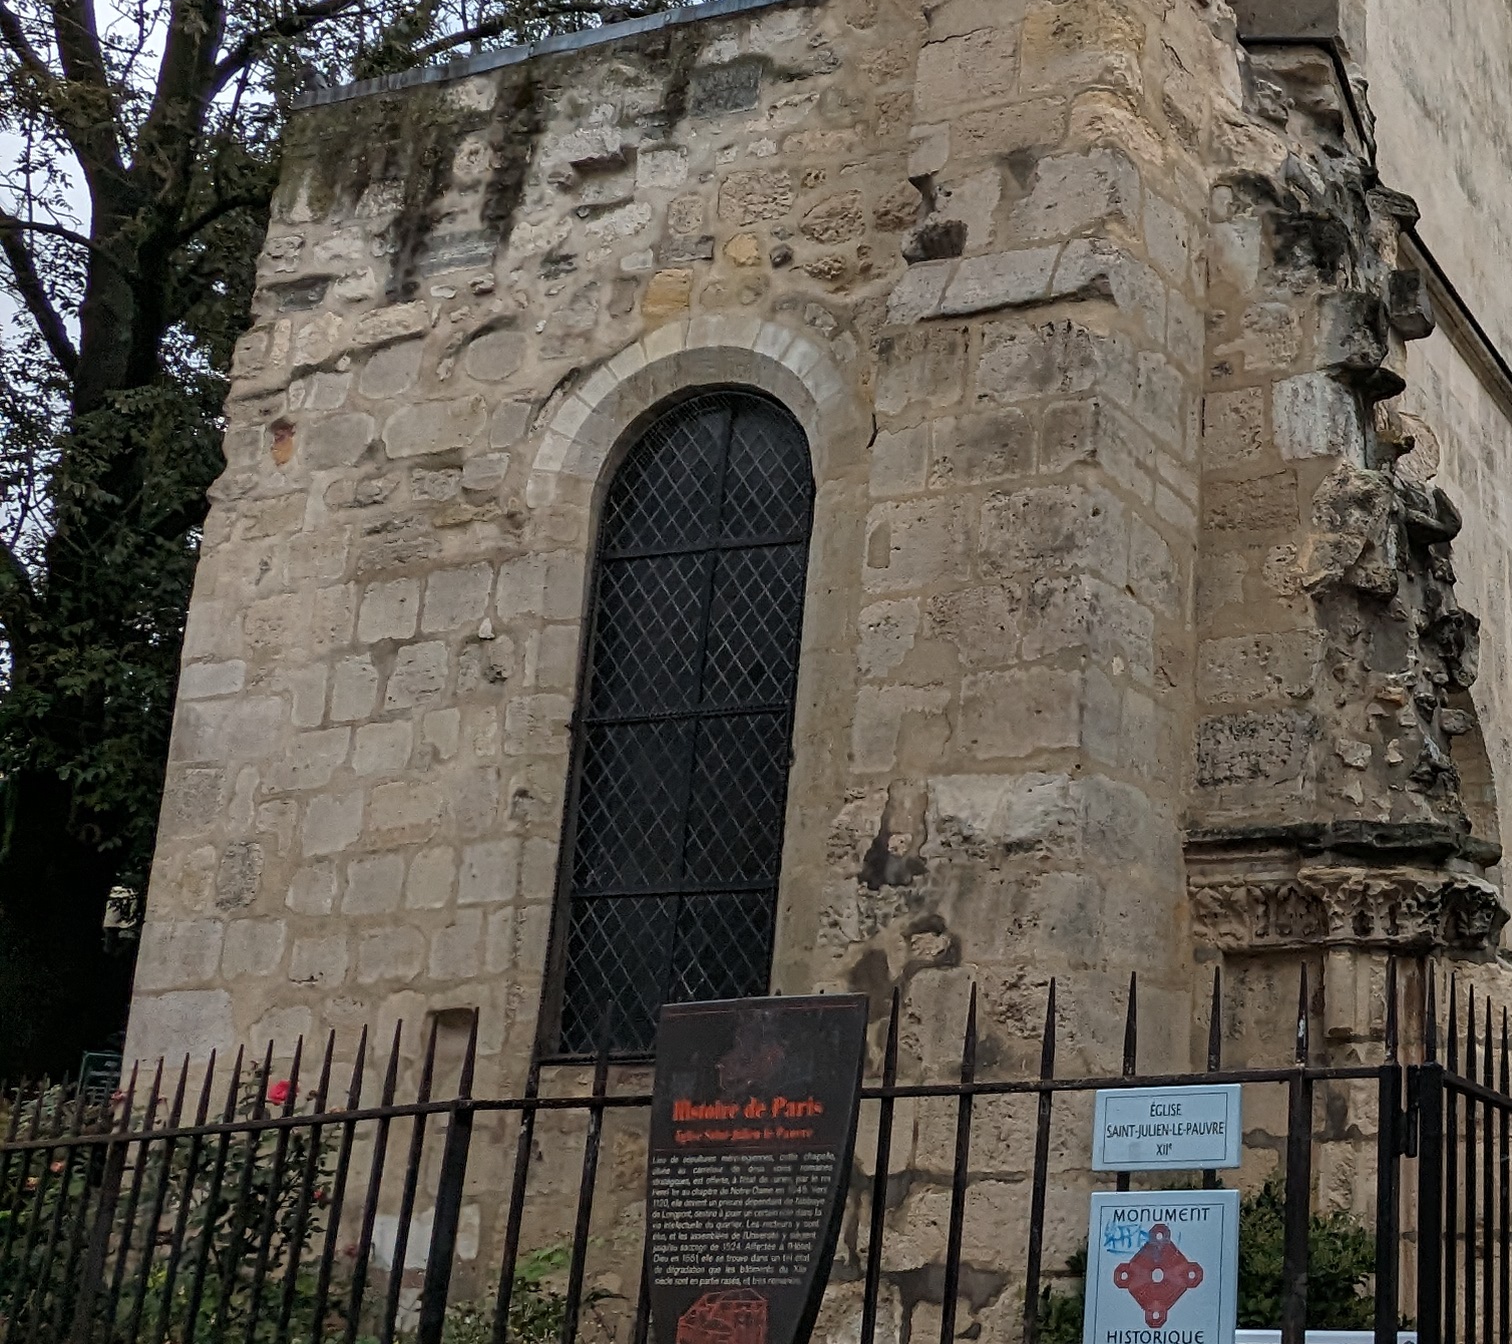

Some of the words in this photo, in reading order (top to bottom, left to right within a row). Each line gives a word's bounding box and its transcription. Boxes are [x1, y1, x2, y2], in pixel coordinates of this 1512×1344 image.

[673, 1097, 740, 1121] Histoire
[743, 1096, 767, 1119] de
[771, 1096, 824, 1119] Paris
[1150, 1101, 1182, 1117] ÉGLISE
[1106, 1121, 1225, 1139] SAINT-JULIEN-LE-PAUVRE
[796, 1177, 808, 1185] par
[652, 1211, 660, 1219] de
[814, 1208, 821, 1216] la
[1113, 1207, 1211, 1223] MONUMENT
[747, 1219, 759, 1228] Les
